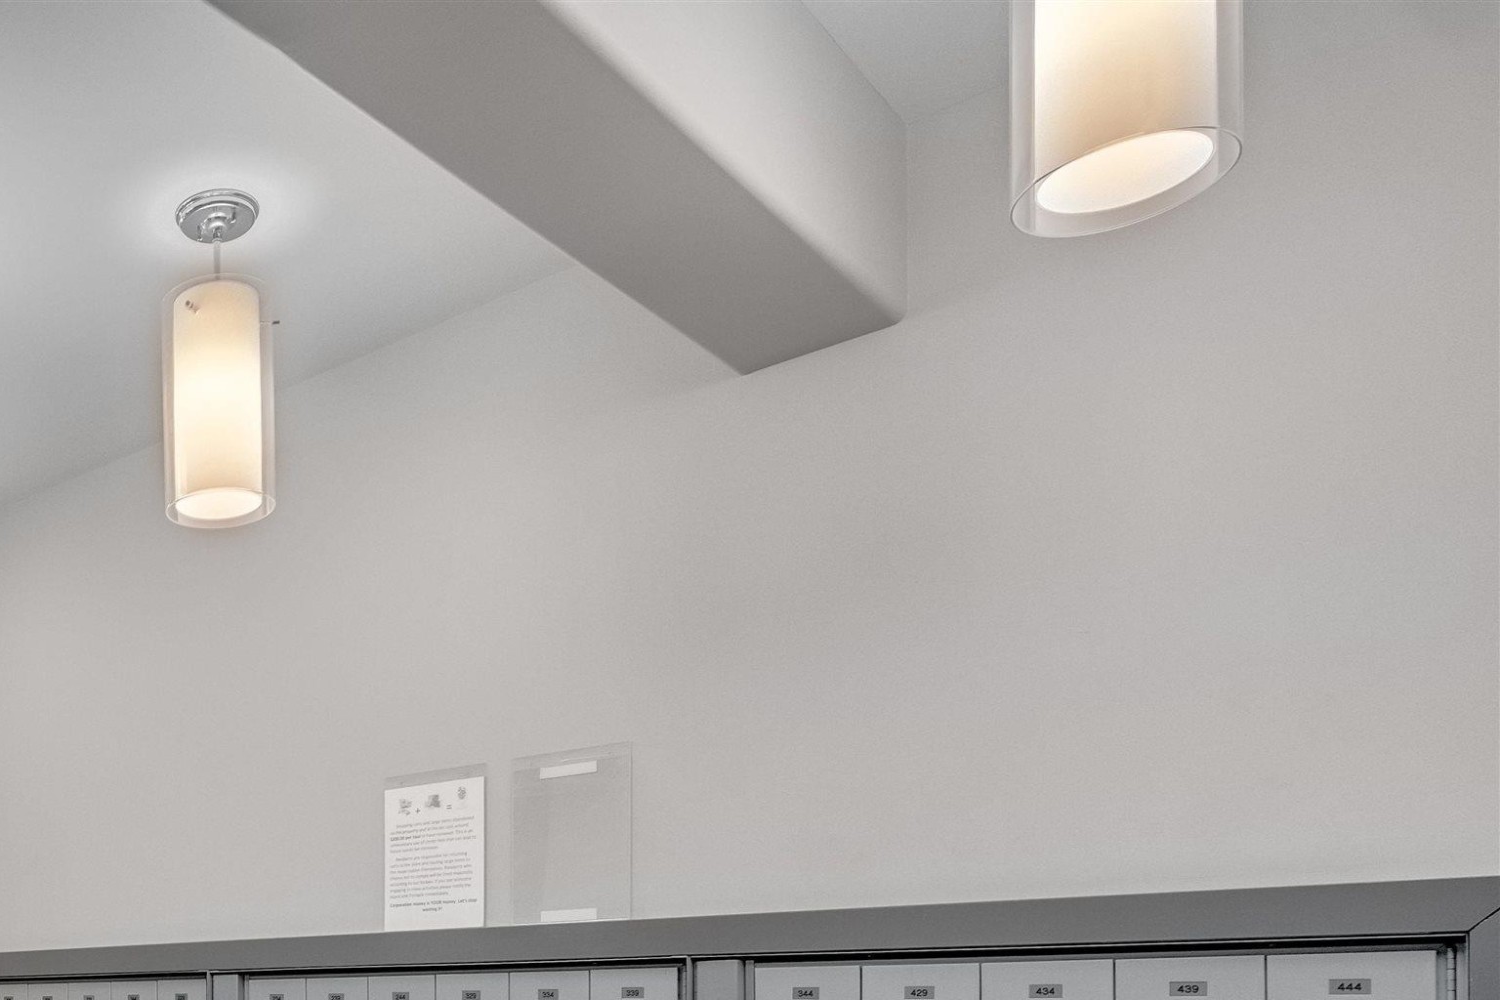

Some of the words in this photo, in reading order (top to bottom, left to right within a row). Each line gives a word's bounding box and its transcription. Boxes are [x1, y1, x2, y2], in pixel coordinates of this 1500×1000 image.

[1177, 984, 1200, 994] 439
[1337, 982, 1362, 991] 444
[626, 989, 640, 997] 339
[797, 989, 814, 998] 344
[910, 988, 928, 997] 429
[1035, 987, 1055, 996] 434
